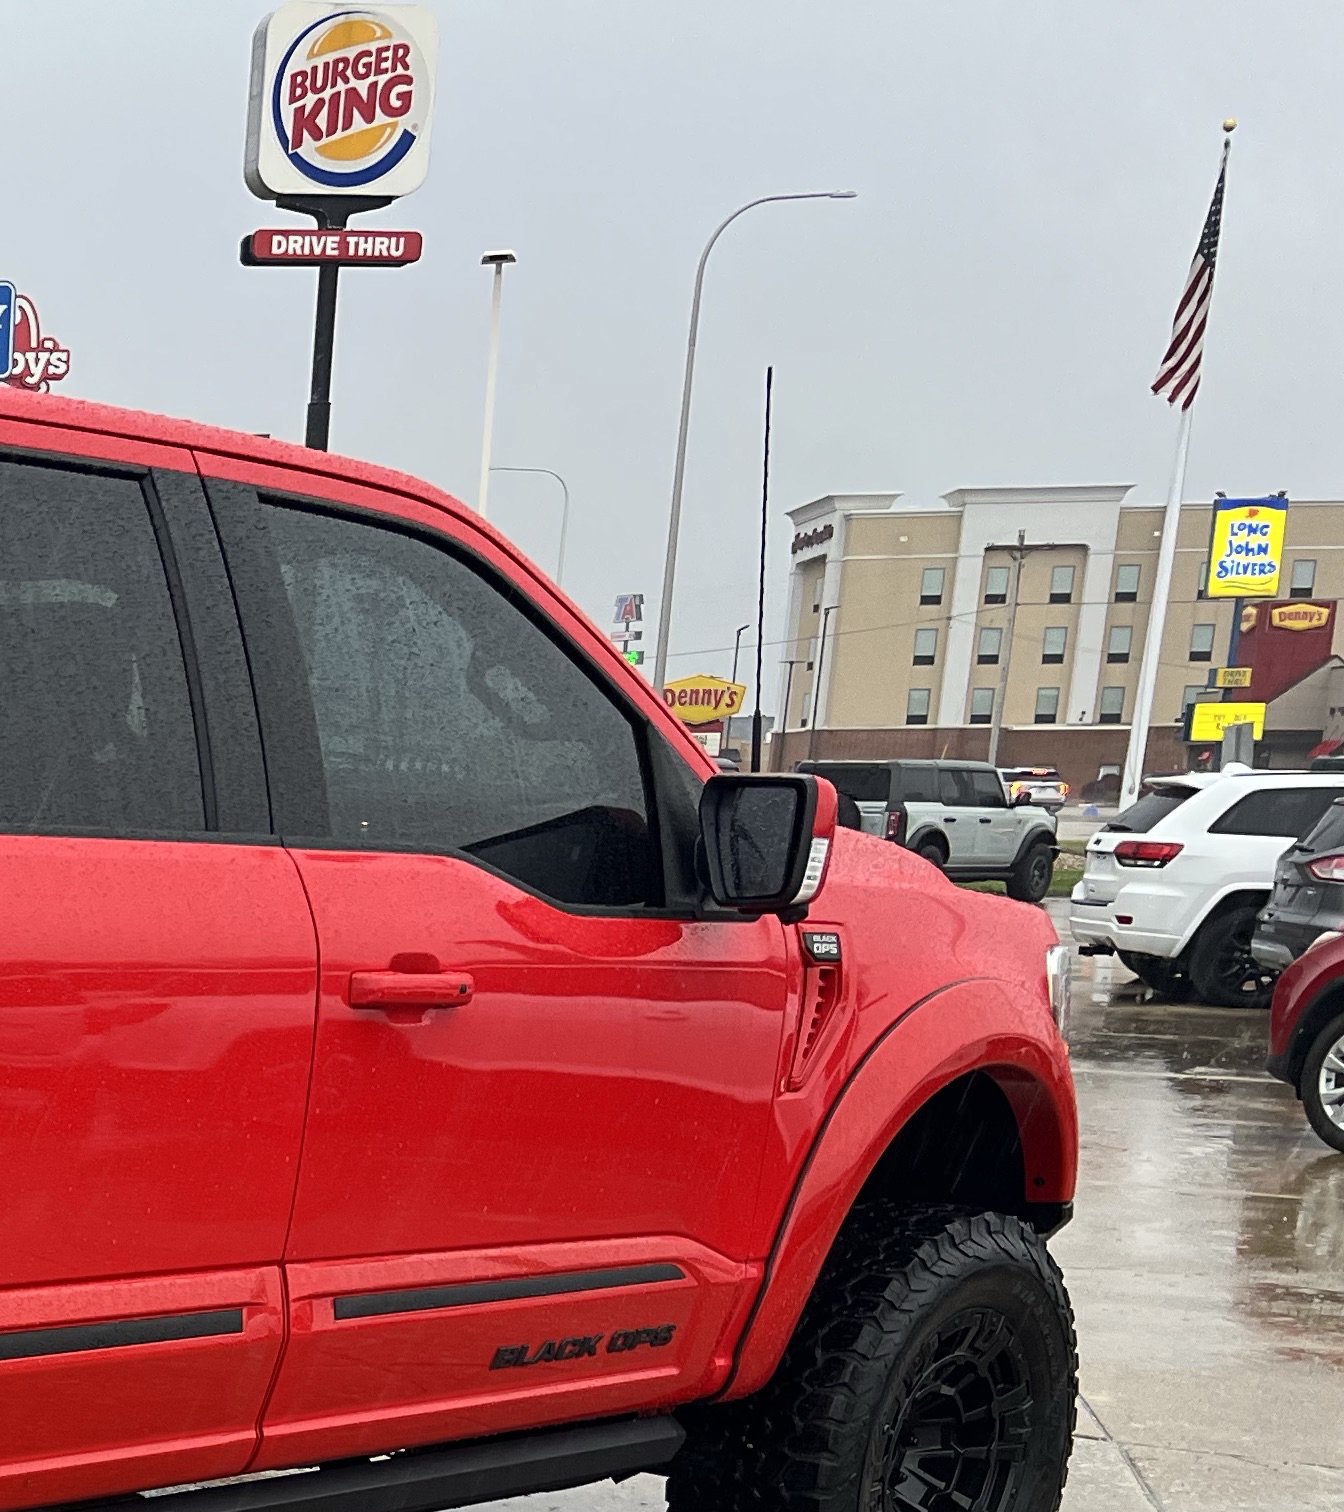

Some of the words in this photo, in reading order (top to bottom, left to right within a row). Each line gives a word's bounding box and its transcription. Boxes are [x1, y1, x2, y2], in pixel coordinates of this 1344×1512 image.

[288, 43, 411, 105] BURGER
[291, 74, 414, 152] KING
[270, 235, 340, 256] DRIVE
[346, 236, 406, 257] THRU
[1230, 522, 1271, 537] LONG
[1278, 610, 1324, 623] Denny's
[662, 686, 738, 710] Denny's
[812, 934, 837, 942] BLACK
[813, 943, 838, 954] OPS
[489, 1332, 605, 1371] BLACK
[606, 1323, 677, 1354] OPS
